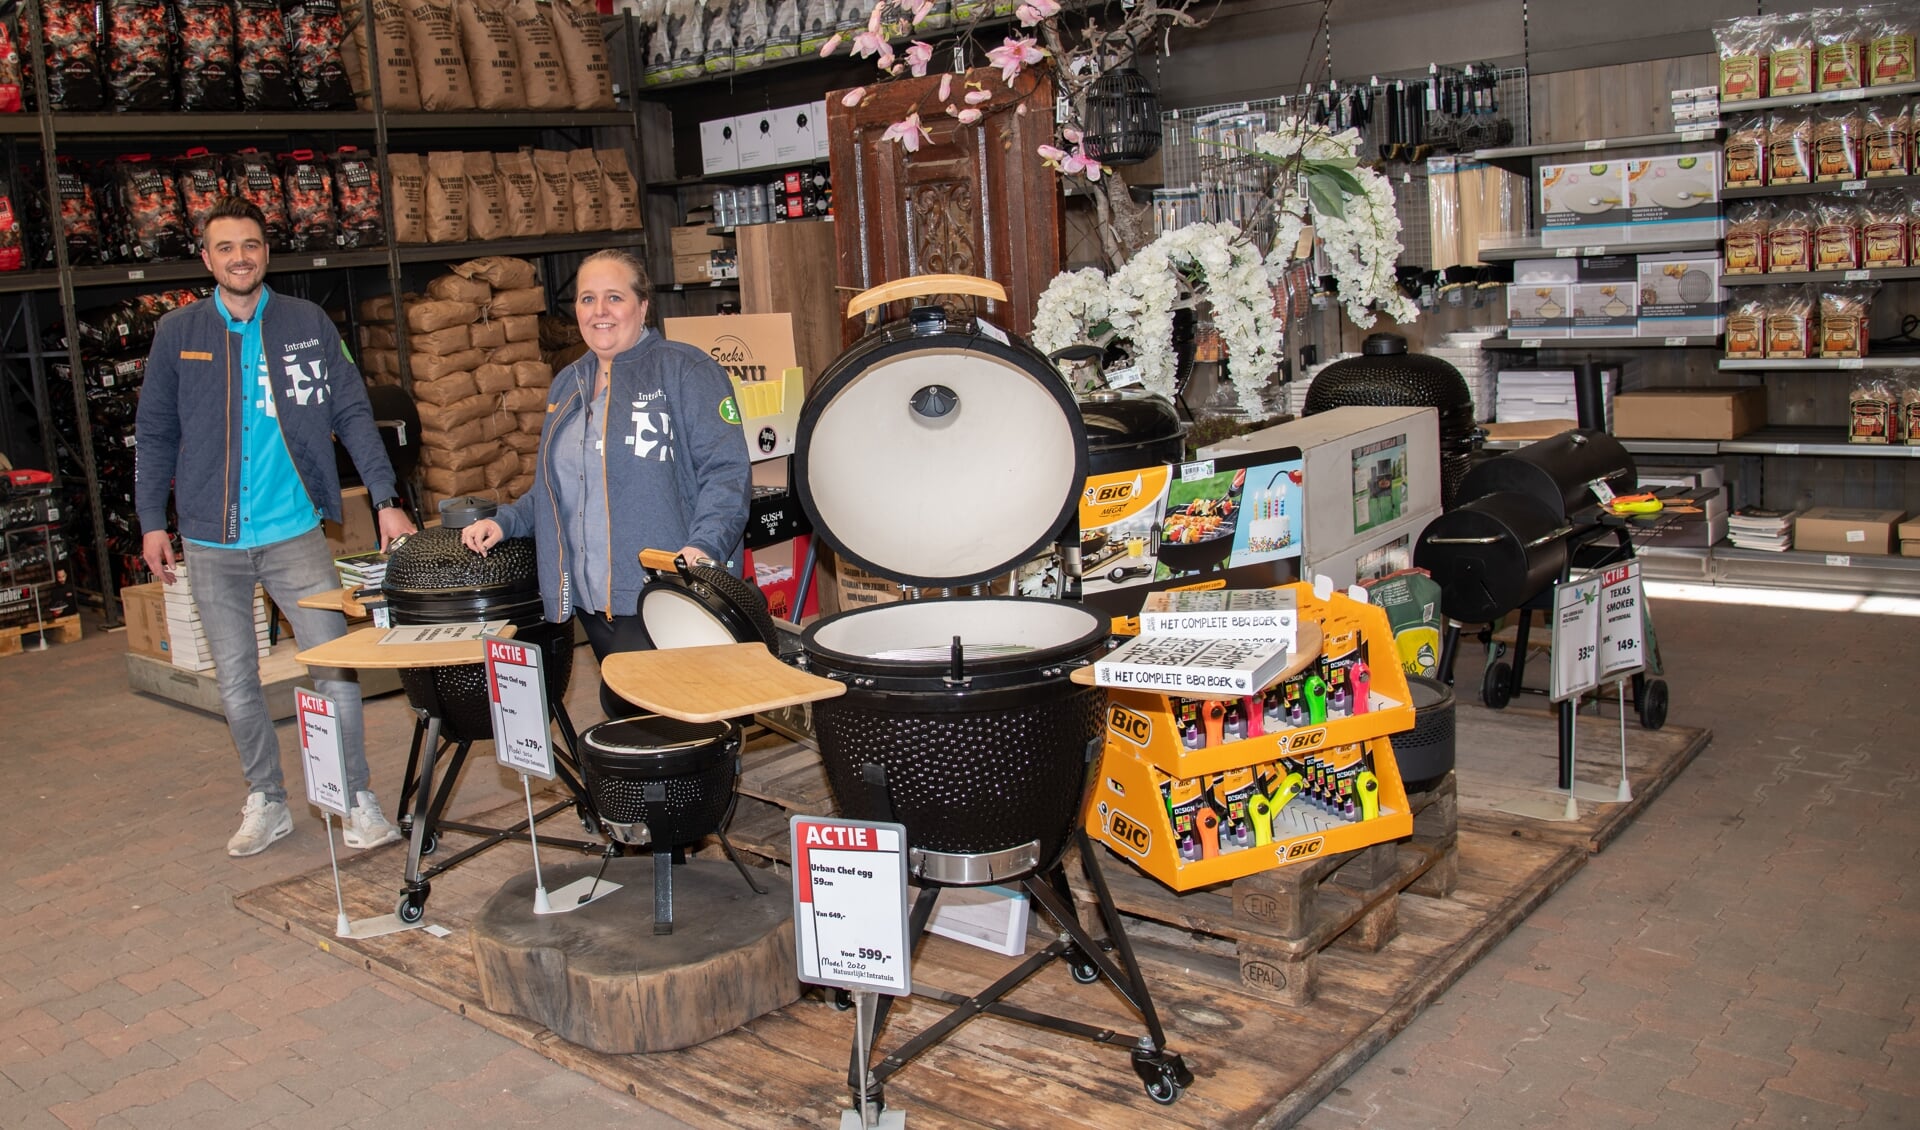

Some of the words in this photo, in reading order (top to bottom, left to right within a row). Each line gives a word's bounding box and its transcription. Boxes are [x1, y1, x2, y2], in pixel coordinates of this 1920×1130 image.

[284, 338, 320, 352] Intratuin
[710, 347, 745, 363] Socks
[722, 365, 767, 382] NU
[228, 503, 238, 539] Intratuin
[761, 510, 784, 524] SUSHI
[562, 572, 570, 615] Intratuin
[1610, 585, 1631, 599] TEXAS
[1606, 598, 1634, 613] SMOKER
[1160, 619, 1180, 630] HET
[1181, 617, 1228, 630] COMPLETE
[1232, 617, 1251, 627] BBQ
[1252, 617, 1277, 627] BOEK
[491, 643, 522, 662] ACTIE
[1115, 671, 1134, 683] HET
[1135, 672, 1182, 686] COMPLETE
[1186, 675, 1205, 686] BBQ
[1207, 676, 1233, 688] BOEK
[302, 695, 324, 712] ACTIE
[525, 738, 542, 752] 179,-
[806, 826, 868, 846] ACTIE
[810, 864, 836, 873] Urban
[837, 866, 856, 875] Chef
[857, 869, 873, 879] egg
[813, 877, 834, 886] 59cm
[816, 910, 828, 918] Van
[828, 911, 846, 920] 649,-
[1251, 898, 1277, 919] EUR
[821, 957, 843, 968] Model
[847, 962, 867, 970] 2020
[841, 950, 855, 958] Voor
[858, 948, 892, 964] 599,-
[1249, 965, 1280, 988] EPAL
